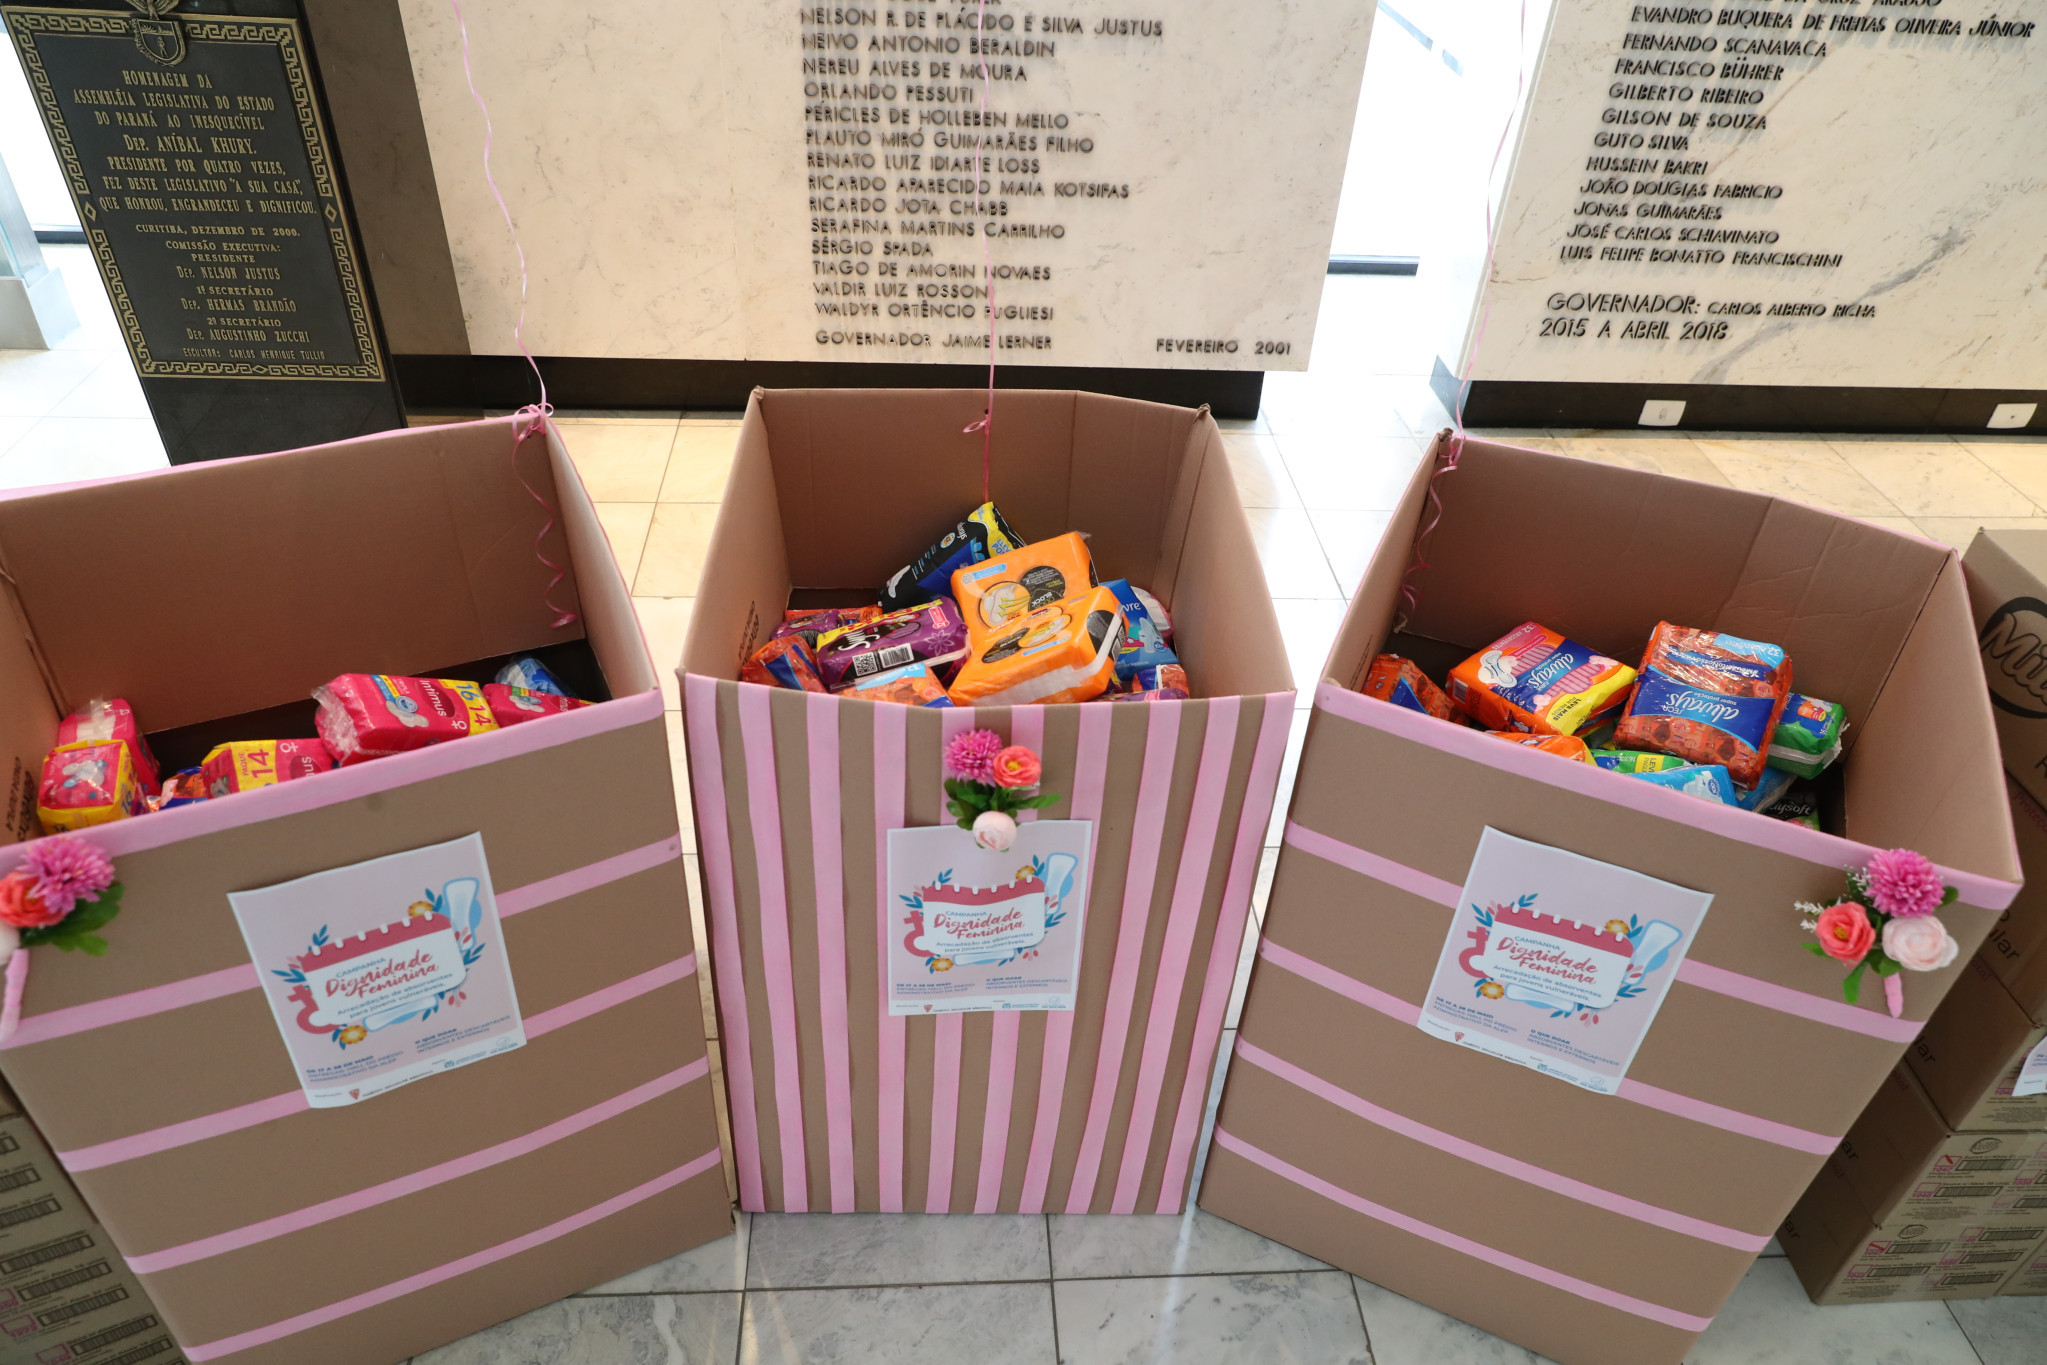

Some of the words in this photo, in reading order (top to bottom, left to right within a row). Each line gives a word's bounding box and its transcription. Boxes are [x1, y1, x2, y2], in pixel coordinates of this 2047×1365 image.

[800, 7, 876, 26] NELSON
[887, 11, 898, 27] R.
[905, 11, 926, 28] DE
[936, 7, 1014, 31] PLÁCIDO
[1024, 16, 1033, 32] E
[1042, 16, 1083, 34] SILVA
[1094, 17, 1163, 37] JUSTUS
[1631, 6, 1713, 25] EVANDRO
[1716, 8, 1794, 31] BUQUERA
[1802, 13, 1825, 30] DE
[1828, 14, 1888, 33] FREITAS
[1895, 17, 1963, 35] OLIVEIRA
[1968, 13, 2037, 38] JÚNIOR
[802, 33, 858, 50] NEIVO
[868, 35, 960, 53] ANTONIO
[969, 37, 1055, 57] BERALDIN
[1622, 33, 1718, 52] FERNANDO
[1723, 37, 1828, 58] SCANAVACA
[803, 58, 859, 76] NEREU
[869, 60, 921, 77] ALVES
[930, 62, 950, 78] DE
[960, 63, 1027, 82] MOURA
[1614, 58, 1715, 78] FRANCISCO
[122, 70, 189, 88] HOMENAGEM
[197, 73, 213, 89] DA
[142, 92, 209, 109] LEGISLATIVA
[215, 95, 230, 110] DO
[239, 97, 275, 112] ESTADO
[804, 82, 897, 101] ORLANDO
[906, 86, 973, 103] PESSUTI
[1608, 82, 1693, 102] GILBERTO
[1700, 87, 1764, 105] RIBEIRO
[94, 111, 110, 125] DO
[116, 110, 158, 128] PARANÁ
[167, 114, 181, 128] AO
[805, 101, 880, 124] PÉRICLES
[889, 108, 910, 124] DE
[920, 109, 1007, 128] HOLLEBEN
[1015, 112, 1069, 130] MELLO
[1601, 108, 1672, 126] GILSON
[1678, 112, 1701, 128] DE
[1706, 112, 1768, 130] SOUZA
[156, 132, 202, 153] ANÍBAL
[805, 129, 871, 146] PLAUTO
[881, 127, 924, 148] MIRÓ
[934, 132, 1037, 152] GUIMARÃES
[1046, 136, 1094, 154] FILHO
[1594, 132, 1644, 149] GUTO
[1648, 134, 1689, 150] SILVA
[107, 156, 168, 172] PRESIDENTE
[175, 159, 196, 173] POR
[203, 160, 242, 175] QUATRO
[807, 153, 875, 169] RENATO
[885, 154, 921, 171] LUIZ
[930, 155, 991, 173] IDIARTE
[998, 158, 1040, 174] LOSS
[1586, 156, 1658, 174] HUSSEIN
[1664, 159, 1708, 175] BAKRI
[102, 176, 122, 190] FEZ
[128, 177, 158, 191] DESTE
[164, 177, 228, 193] LEGISLATIVO
[248, 180, 268, 193] SUA
[808, 175, 886, 192] RICARDO
[898, 177, 991, 195] APARECIDO
[1000, 181, 1044, 197] MAIA
[1054, 181, 1130, 200] KOTSIFAS
[1580, 178, 1629, 195] JOÃO
[1632, 182, 1708, 198] DOUGLAS
[1713, 184, 1784, 200] FABRICIO
[99, 197, 120, 212] QUE
[173, 198, 240, 213] ENGRANDECEU
[247, 200, 254, 212] E
[809, 197, 886, 213] RICARDO
[895, 198, 941, 215] JOTA
[949, 200, 1009, 217] CHABB
[1574, 201, 1628, 217] JONAS
[1636, 203, 1723, 221] GUIMARÃES
[191, 226, 245, 235] DEZEMBRO
[251, 227, 266, 236] DE
[811, 218, 891, 235] SERAFINA
[901, 220, 976, 237] MARTINS
[984, 222, 1066, 240] CARRILHO
[1567, 223, 1610, 240] JOSÉ
[1614, 226, 1672, 241] CARLOS
[1678, 228, 1780, 245] SCHIAVINATO
[811, 235, 873, 256] SÉRGIO
[883, 240, 934, 257] SPADA
[1560, 246, 1593, 260] LUIS
[1600, 248, 1644, 261] FELIPE
[1649, 249, 1725, 264] BONATTO
[1732, 251, 1843, 268] FRANCISCHINI
[191, 254, 256, 263] PRESIDENTE
[200, 267, 238, 279] NELSON
[245, 267, 281, 280] JUSTUS
[1547, 292, 1701, 316] GOVERNADOR:
[1707, 301, 1762, 317] CARLOS
[1766, 303, 1826, 318] ALBERTO
[1832, 304, 1876, 319] RICHA
[815, 330, 932, 348] GOVERNADOR
[942, 331, 991, 349] JAIME
[999, 333, 1052, 351] LERNER
[1539, 318, 1589, 338] 2015
[1597, 320, 1611, 339] A
[1620, 320, 1670, 340] ABRIL
[1680, 321, 1728, 341] 2018
[1156, 338, 1239, 354] FEVEREIRO
[1254, 340, 1291, 356] 2001
[1031, 591, 1053, 608] BLOCK
[1527, 652, 1573, 690] always
[419, 680, 447, 717] Intimus
[456, 684, 480, 701] 16
[469, 705, 492, 726] 14
[1665, 690, 1740, 723] always
[247, 748, 274, 778] 14
[933, 906, 1022, 934] Dignidade
[1514, 935, 1561, 951] CAMPANHA
[1496, 936, 1599, 974] Dignidade
[325, 949, 433, 999] Dignidade
